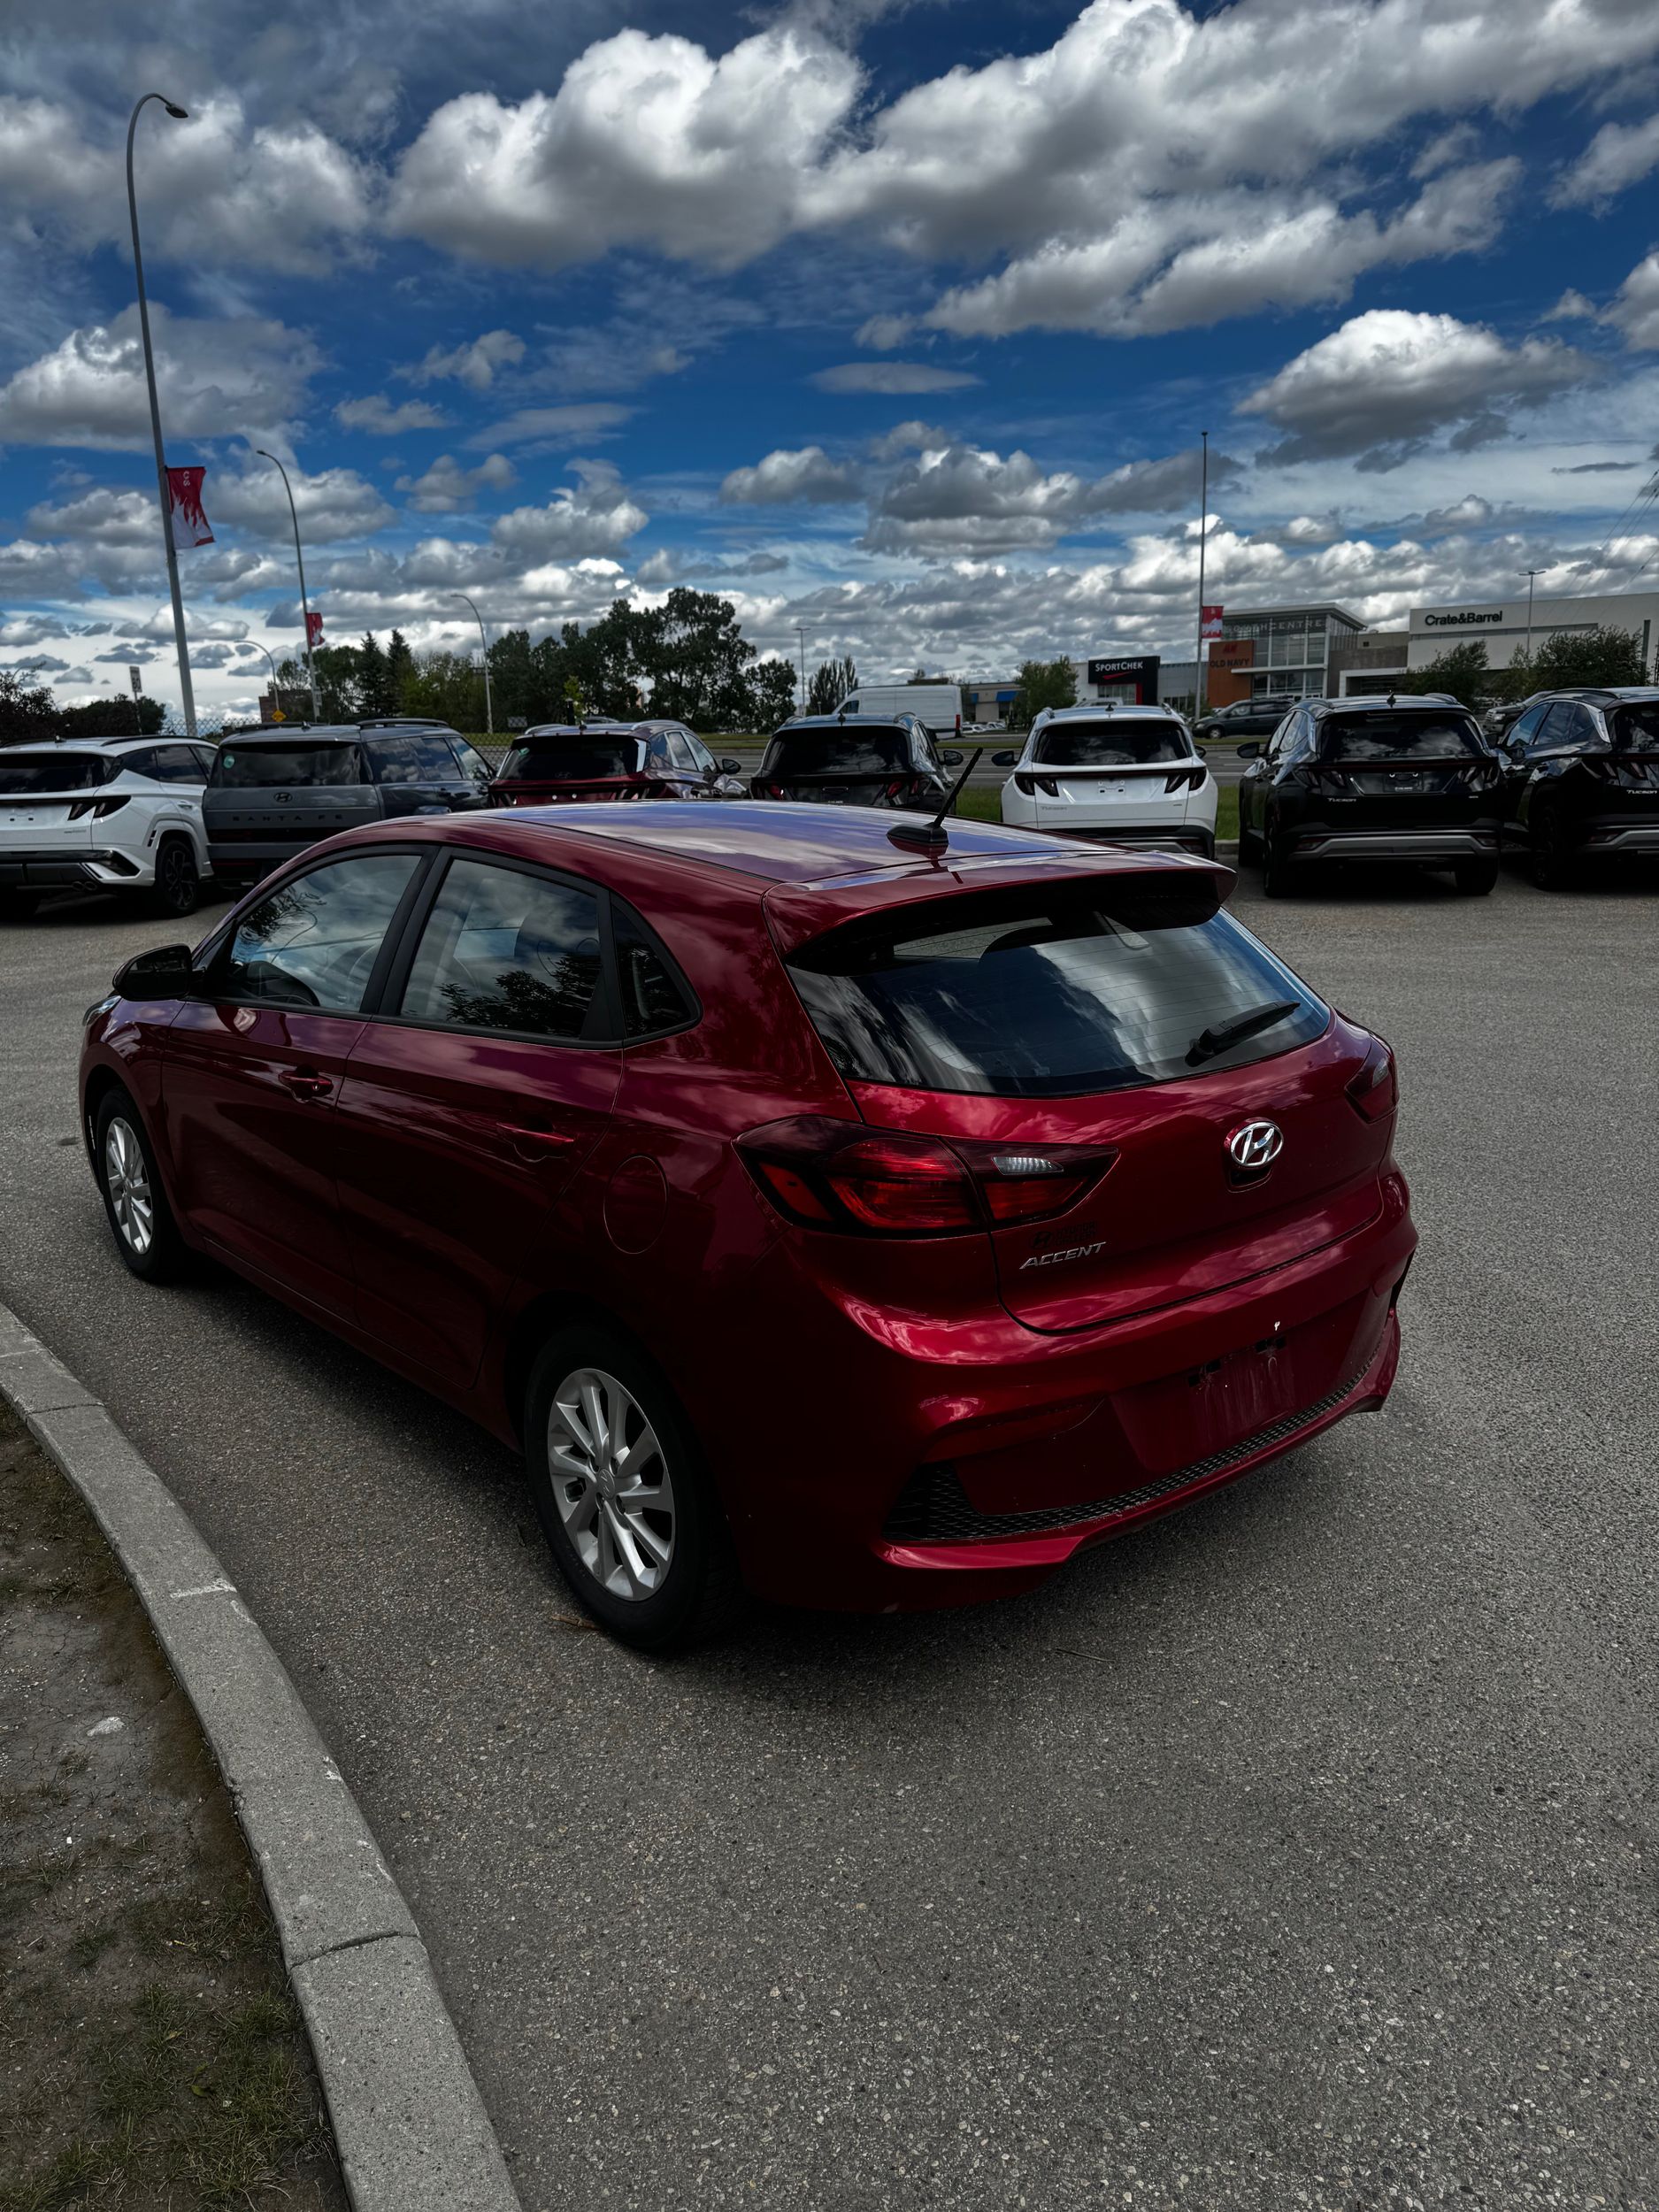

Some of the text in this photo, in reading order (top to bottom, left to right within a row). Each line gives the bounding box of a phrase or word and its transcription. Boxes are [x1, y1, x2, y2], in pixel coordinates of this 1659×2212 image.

[1425, 611, 1502, 626] Crate&Barrel
[1227, 657, 1249, 666] NAVY
[1019, 1241, 1106, 1270] ACCENT
